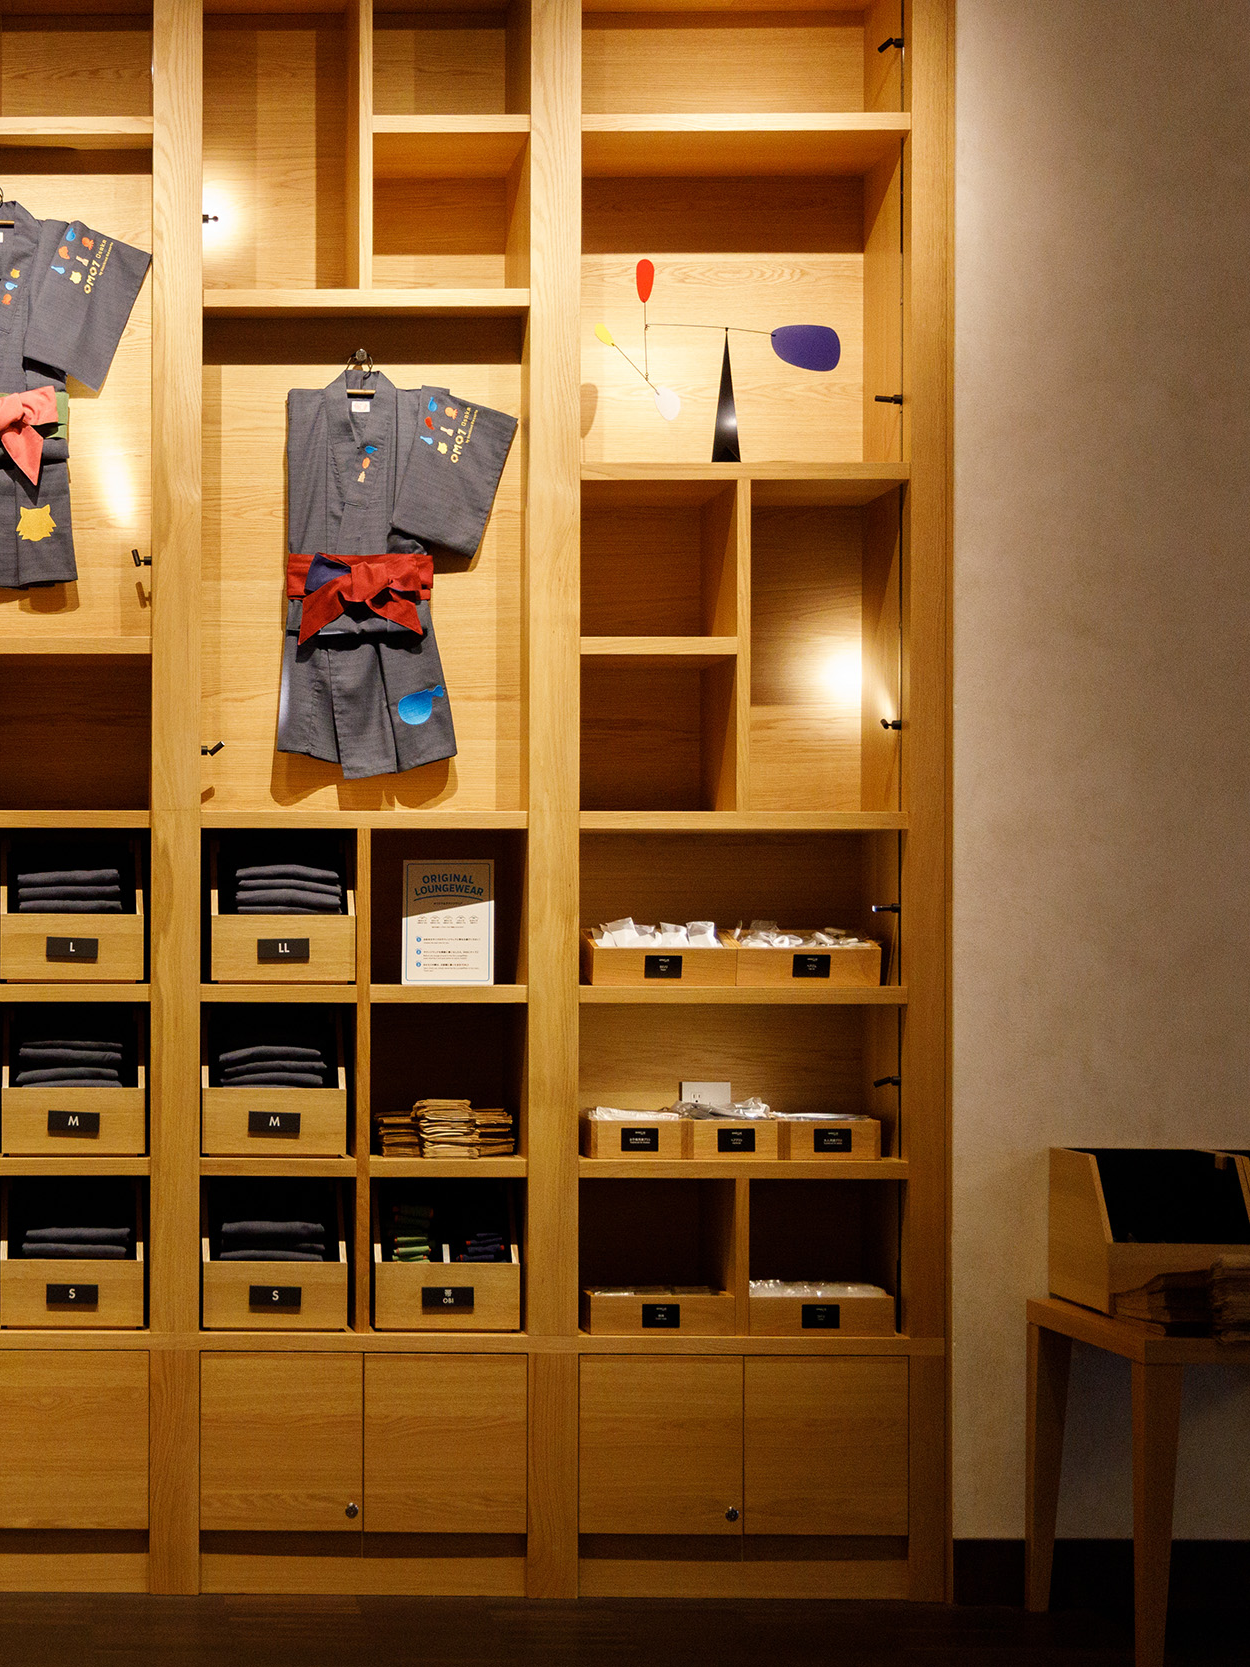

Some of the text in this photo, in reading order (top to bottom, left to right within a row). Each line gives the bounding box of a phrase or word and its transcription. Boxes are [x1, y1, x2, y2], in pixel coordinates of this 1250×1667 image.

[84, 260, 100, 294] OMO7
[450, 428, 467, 463] OMO7
[422, 873, 474, 884] ORIGINAL
[414, 883, 484, 897] LOUNGEWEAR
[69, 941, 76, 952] L
[278, 942, 290, 953] LL
[67, 1115, 80, 1127] M
[268, 1116, 280, 1127] M
[68, 1288, 76, 1299] S
[271, 1290, 279, 1301] S
